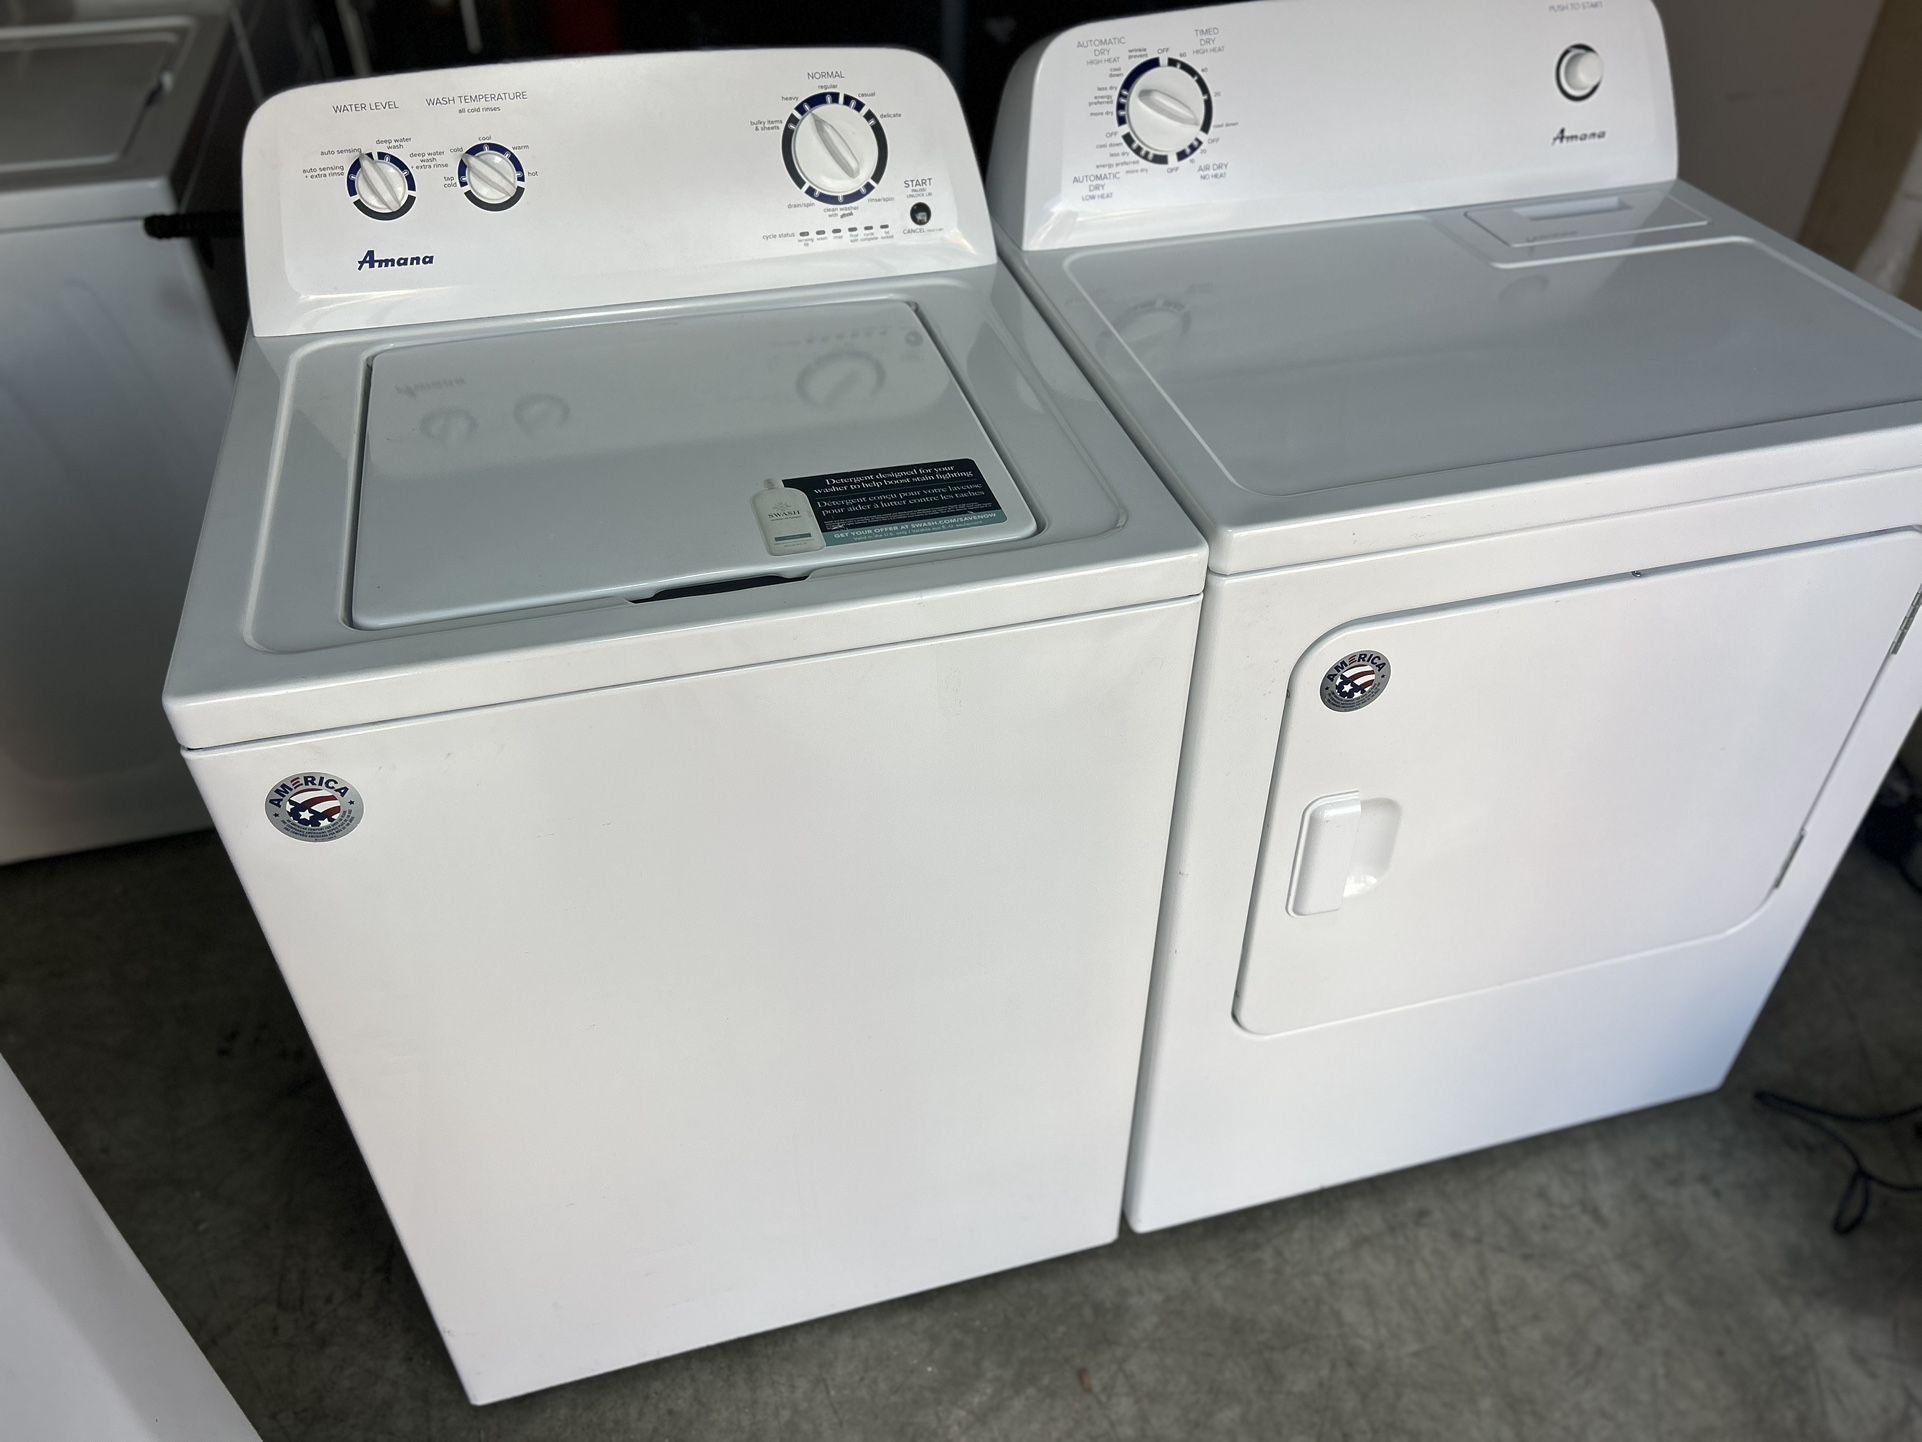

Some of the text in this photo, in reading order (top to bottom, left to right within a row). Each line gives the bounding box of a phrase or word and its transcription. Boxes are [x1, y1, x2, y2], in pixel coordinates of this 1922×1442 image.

[1194, 27, 1219, 36] TIMED
[1076, 36, 1126, 49] AUTOMATIC
[1199, 38, 1216, 46] DRY
[1093, 48, 1110, 56] DRY
[807, 71, 845, 80] NORMAL
[425, 91, 528, 107] WASH TEMPERATURE
[332, 100, 399, 114] WATER LEVEL
[375, 136, 412, 146] deep water
[1551, 127, 1606, 146] Amana
[338, 147, 362, 156] sensing
[409, 150, 445, 160] deep water
[302, 164, 345, 174] auto sensing
[1167, 166, 1179, 174] OFF
[1197, 162, 1229, 172] AIR DRY
[904, 178, 933, 188] START
[1072, 173, 1121, 186] AUTOMATIC
[1088, 184, 1106, 192] DRY
[1096, 192, 1113, 200] HEAT
[787, 202, 816, 210] drain/spin
[357, 249, 435, 271] Amana
[825, 474, 875, 486] Detergent
[876, 468, 918, 479] designed
[934, 466, 955, 474] your
[814, 485, 848, 494] washer
[861, 480, 883, 488] help
[883, 478, 910, 486] boost
[912, 475, 935, 483] stain
[936, 470, 974, 480] fighting
[898, 490, 921, 500] pour
[922, 485, 947, 494] votre
[948, 483, 983, 492] laveuse
[821, 508, 846, 517] pour
[846, 505, 872, 513] aider
[880, 500, 908, 508] lutter
[908, 495, 940, 504] contre
[873, 526, 899, 534] OFFER
[910, 512, 996, 529] SWASH.COM/SAVENOW
[1327, 653, 1386, 682] AMERICA
[269, 775, 350, 808] AMERICA
